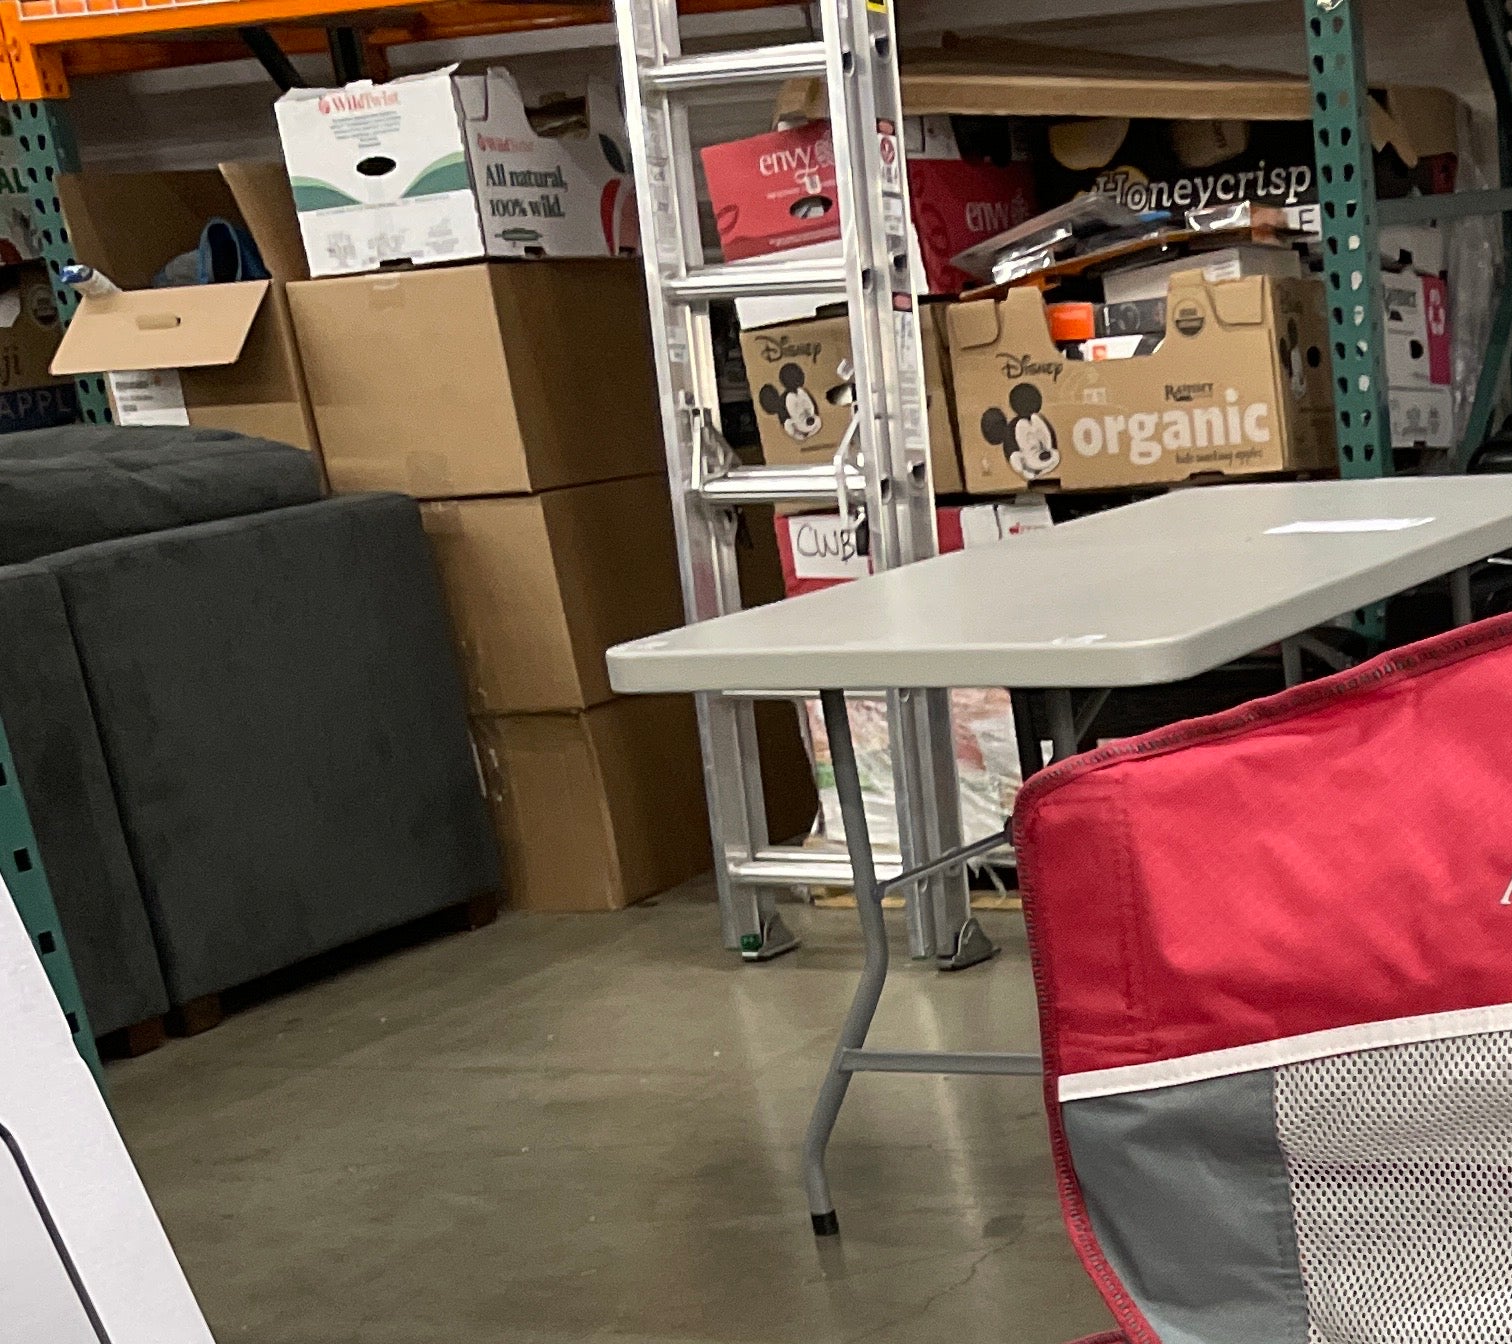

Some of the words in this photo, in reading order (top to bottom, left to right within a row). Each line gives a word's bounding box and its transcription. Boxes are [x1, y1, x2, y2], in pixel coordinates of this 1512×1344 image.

[486, 163, 506, 187] All
[509, 165, 568, 192] natural,
[759, 145, 819, 184] envy
[1095, 160, 1311, 211] Honeycrisp
[490, 199, 527, 217] 100%
[529, 194, 565, 218] wild.
[0, 390, 73, 420] APPL
[1072, 387, 1270, 466] organic
